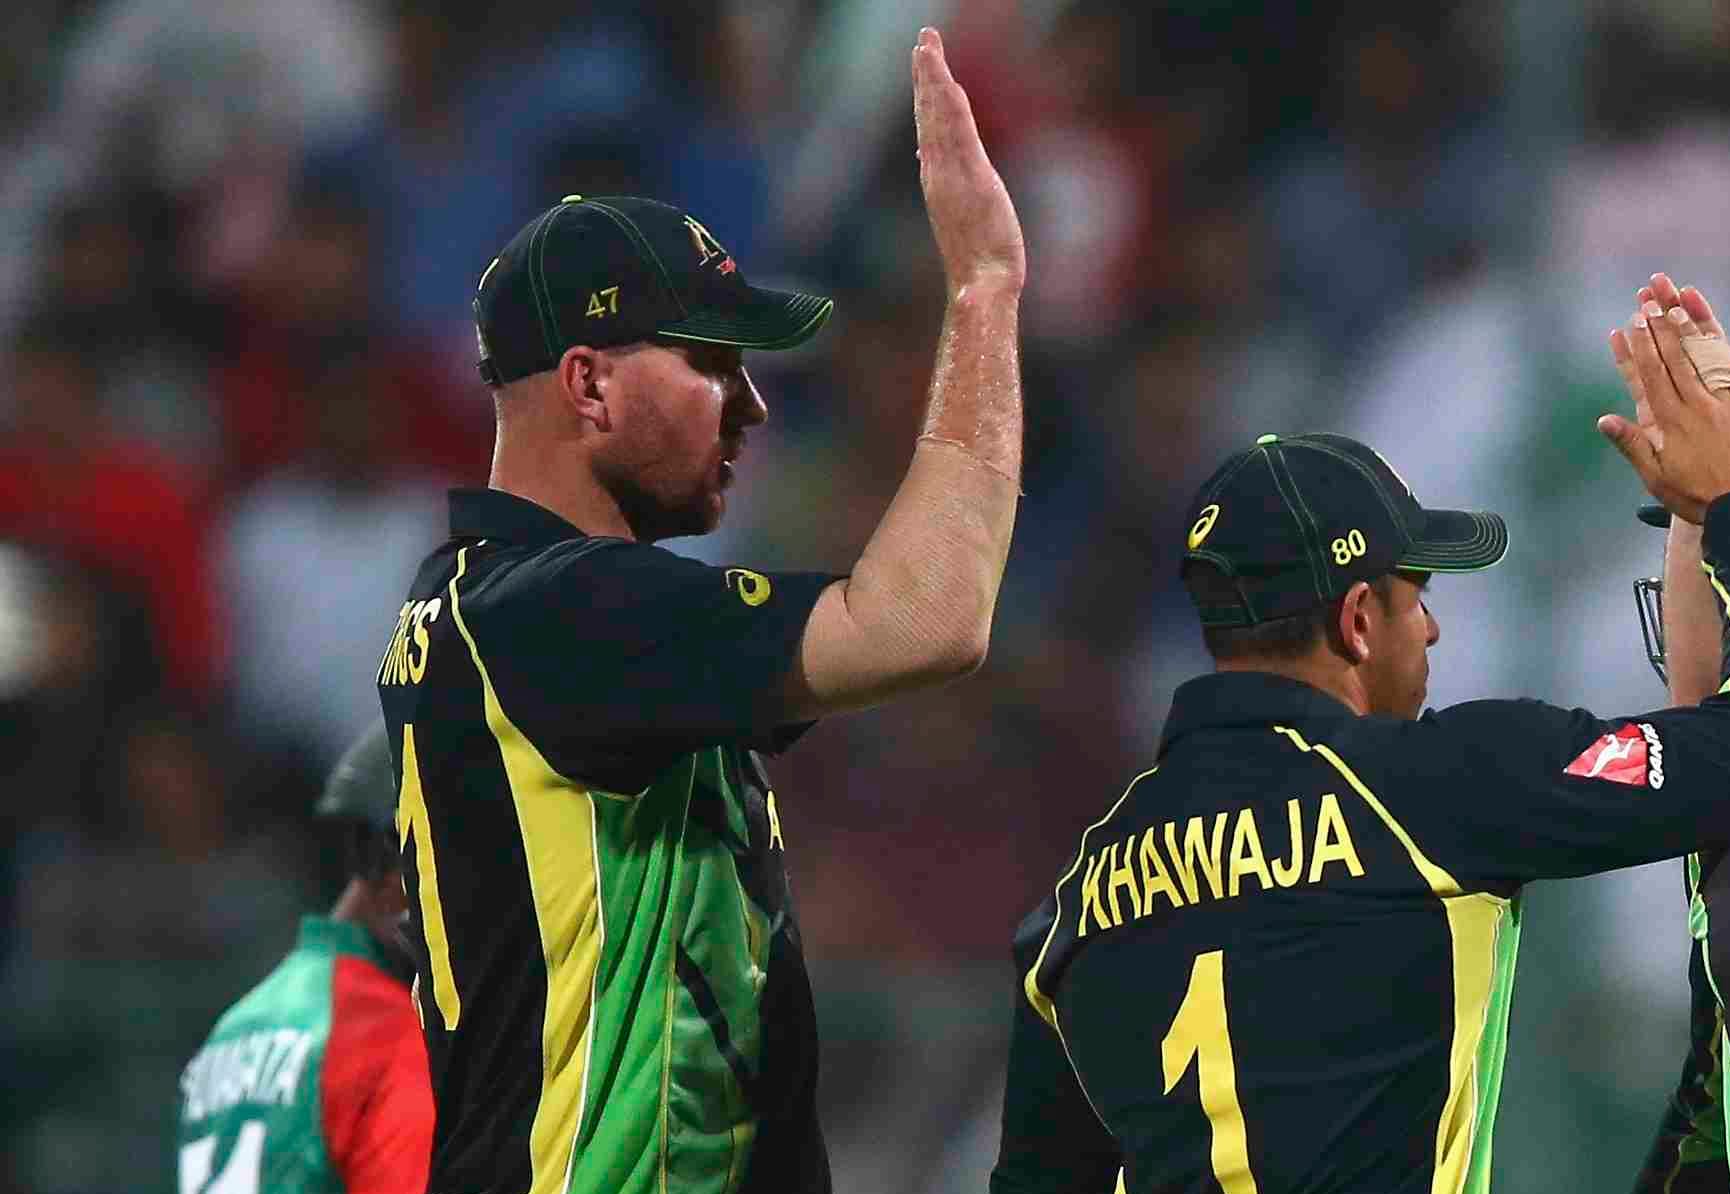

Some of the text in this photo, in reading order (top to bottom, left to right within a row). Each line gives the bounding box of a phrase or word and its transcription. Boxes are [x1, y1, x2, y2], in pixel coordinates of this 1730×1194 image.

[585, 285, 619, 319] 47
[1331, 528, 1366, 565] 80
[1078, 793, 1366, 937] KHAWAJA
